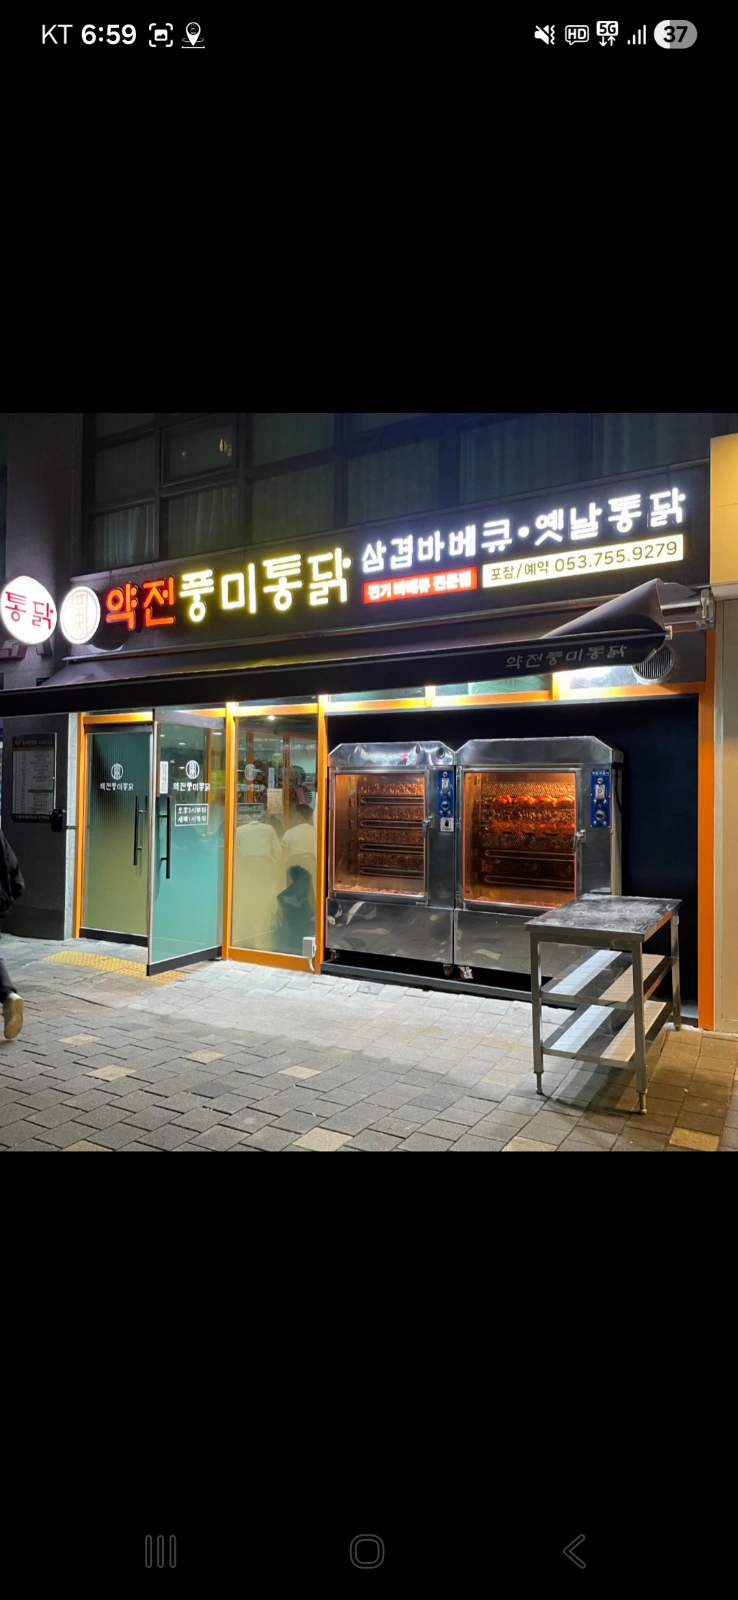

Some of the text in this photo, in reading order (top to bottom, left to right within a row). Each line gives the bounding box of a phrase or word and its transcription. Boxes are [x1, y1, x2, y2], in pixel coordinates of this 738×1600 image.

[490, 541, 678, 581] 포장/예약 053.755.9279
[5, 590, 54, 630] 통닭
[505, 644, 627, 670] 약전풍미통닭
